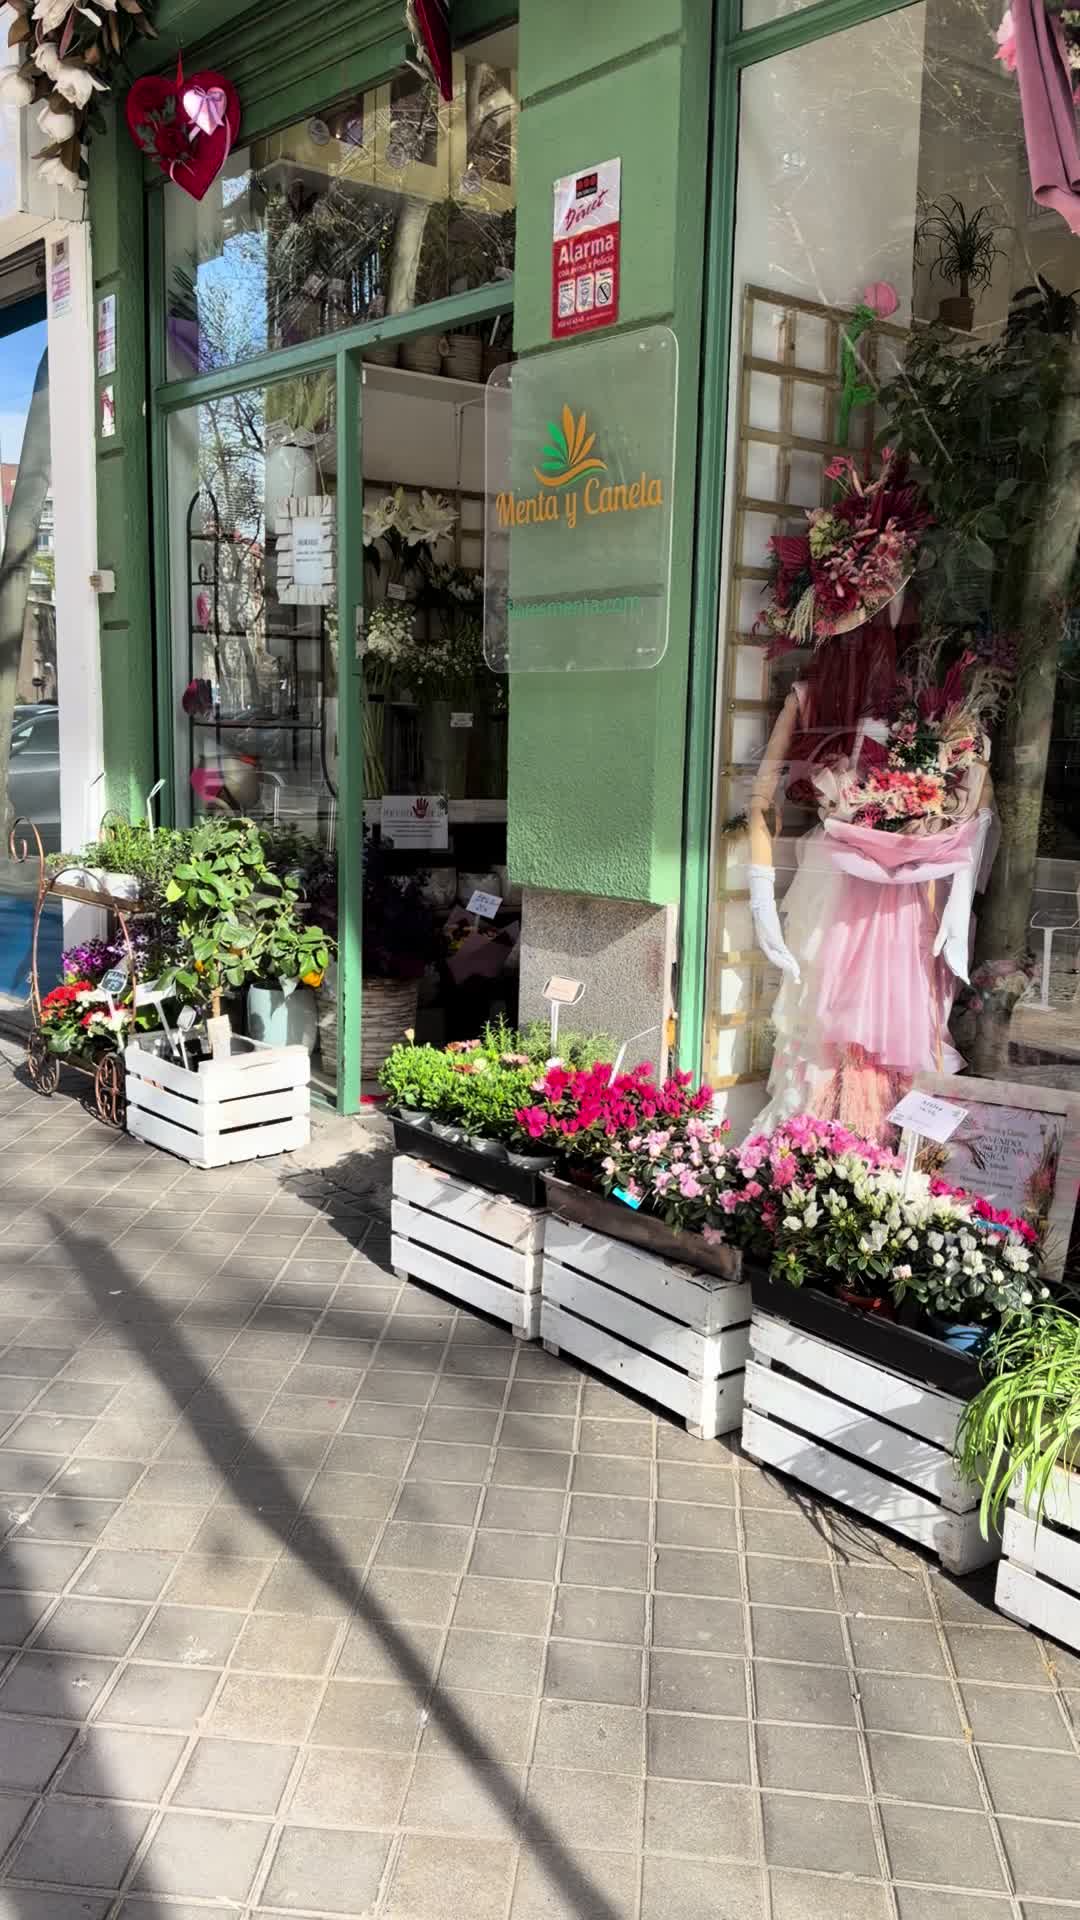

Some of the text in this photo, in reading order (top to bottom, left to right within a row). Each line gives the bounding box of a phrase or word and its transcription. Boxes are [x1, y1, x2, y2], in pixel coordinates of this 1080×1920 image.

[565, 189, 608, 231] Direct
[559, 234, 614, 266] Alarma
[495, 471, 663, 529] Menta y Canela
